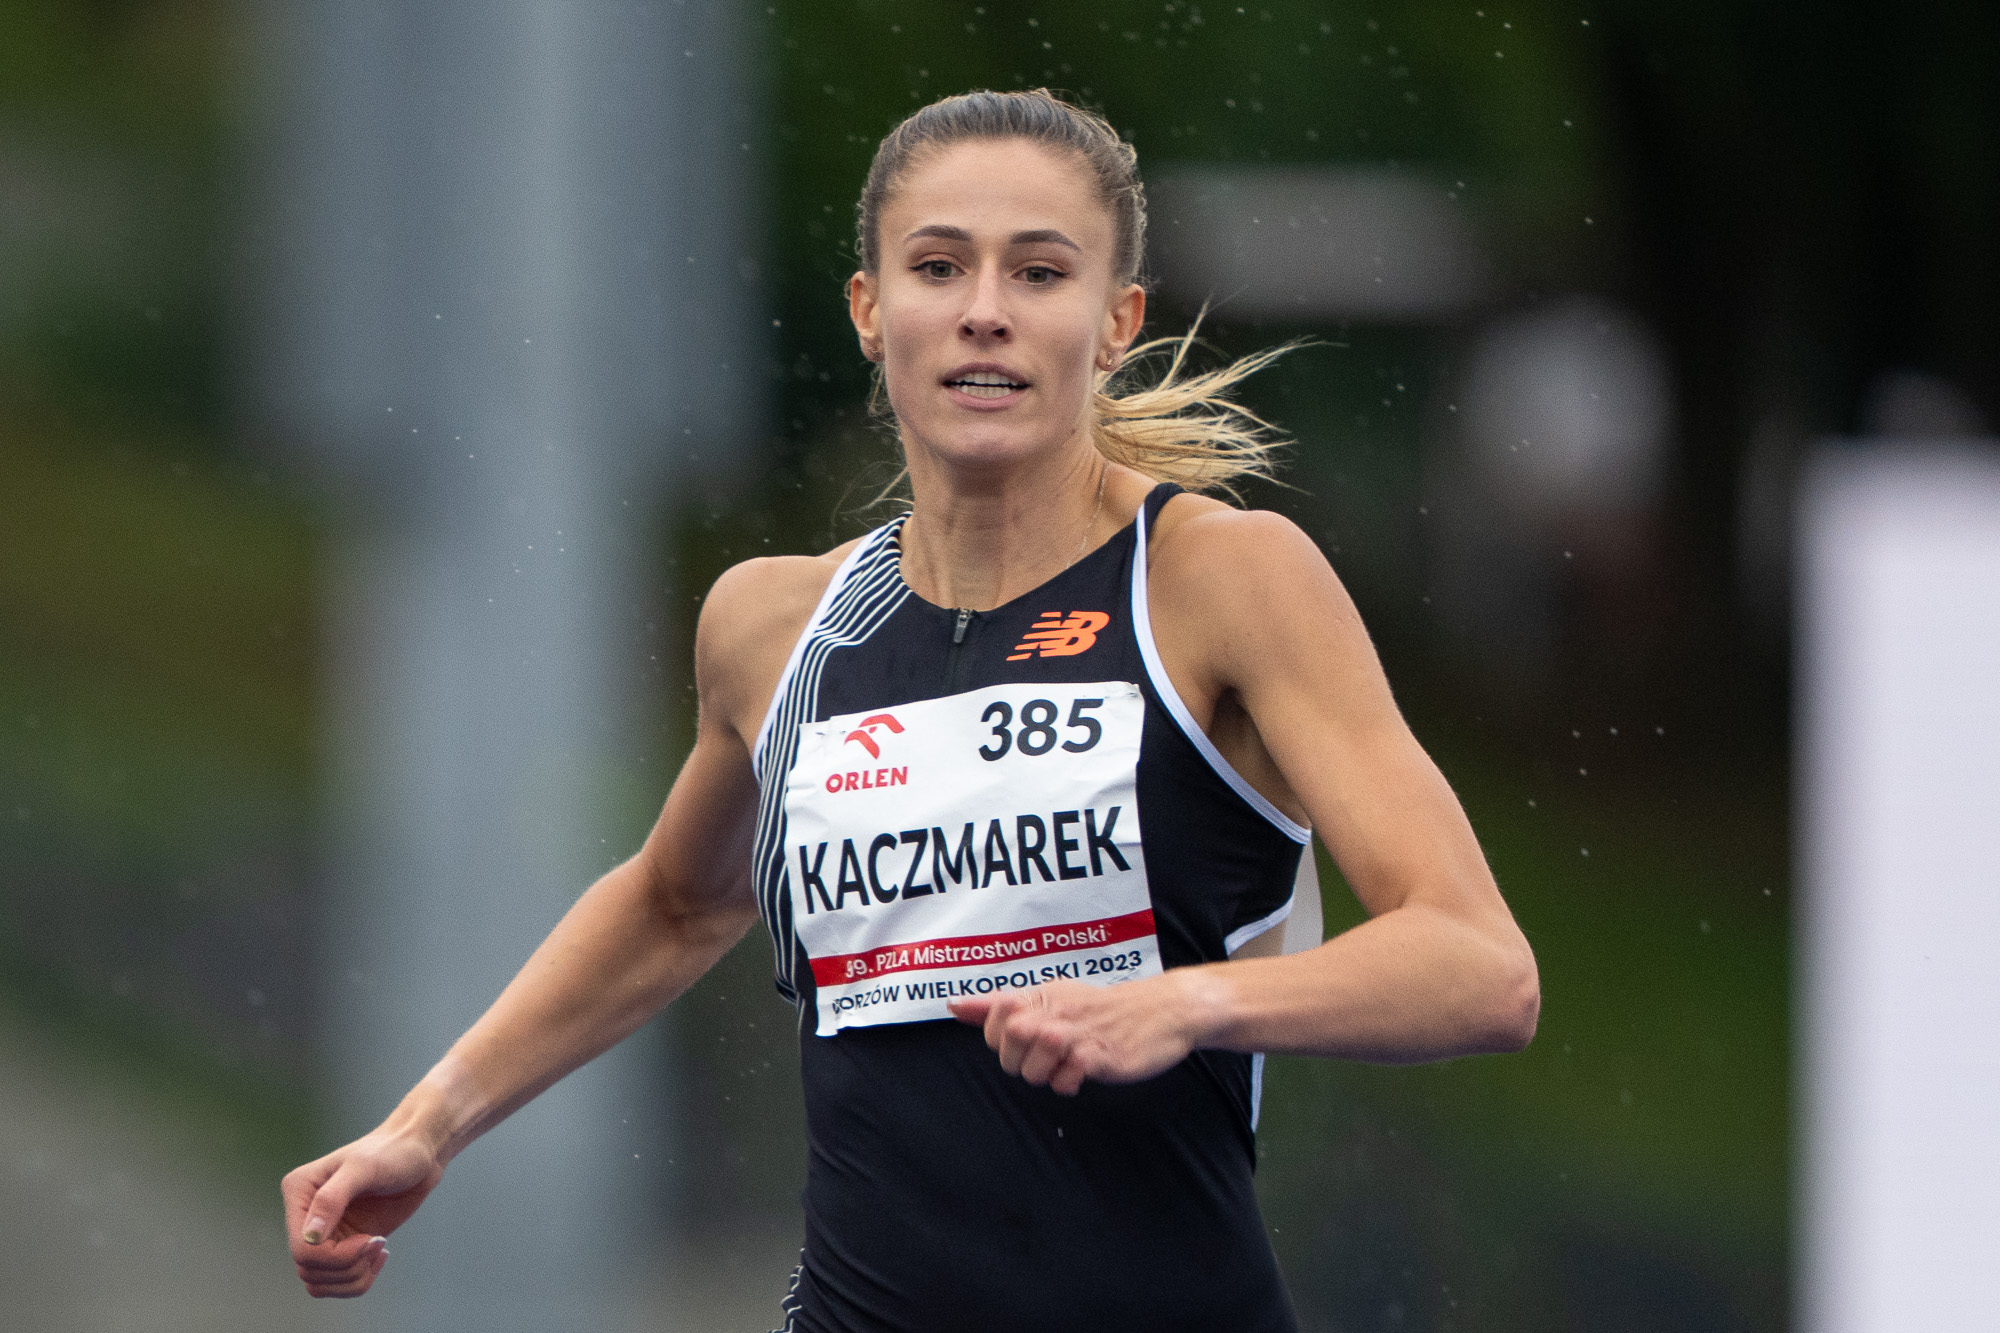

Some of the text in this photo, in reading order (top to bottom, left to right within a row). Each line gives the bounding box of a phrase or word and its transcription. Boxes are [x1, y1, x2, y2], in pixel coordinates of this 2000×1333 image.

[977, 698, 1105, 762] 385
[825, 766, 908, 793] ORLEN
[798, 806, 1132, 915] KACZMAREK
[876, 950, 910, 972] PZLA
[913, 937, 1038, 965] Mistrzostwa
[1042, 924, 1107, 949] Polski
[906, 961, 1080, 1000] WIELKOPOLSKI
[1085, 950, 1143, 976] 2023
